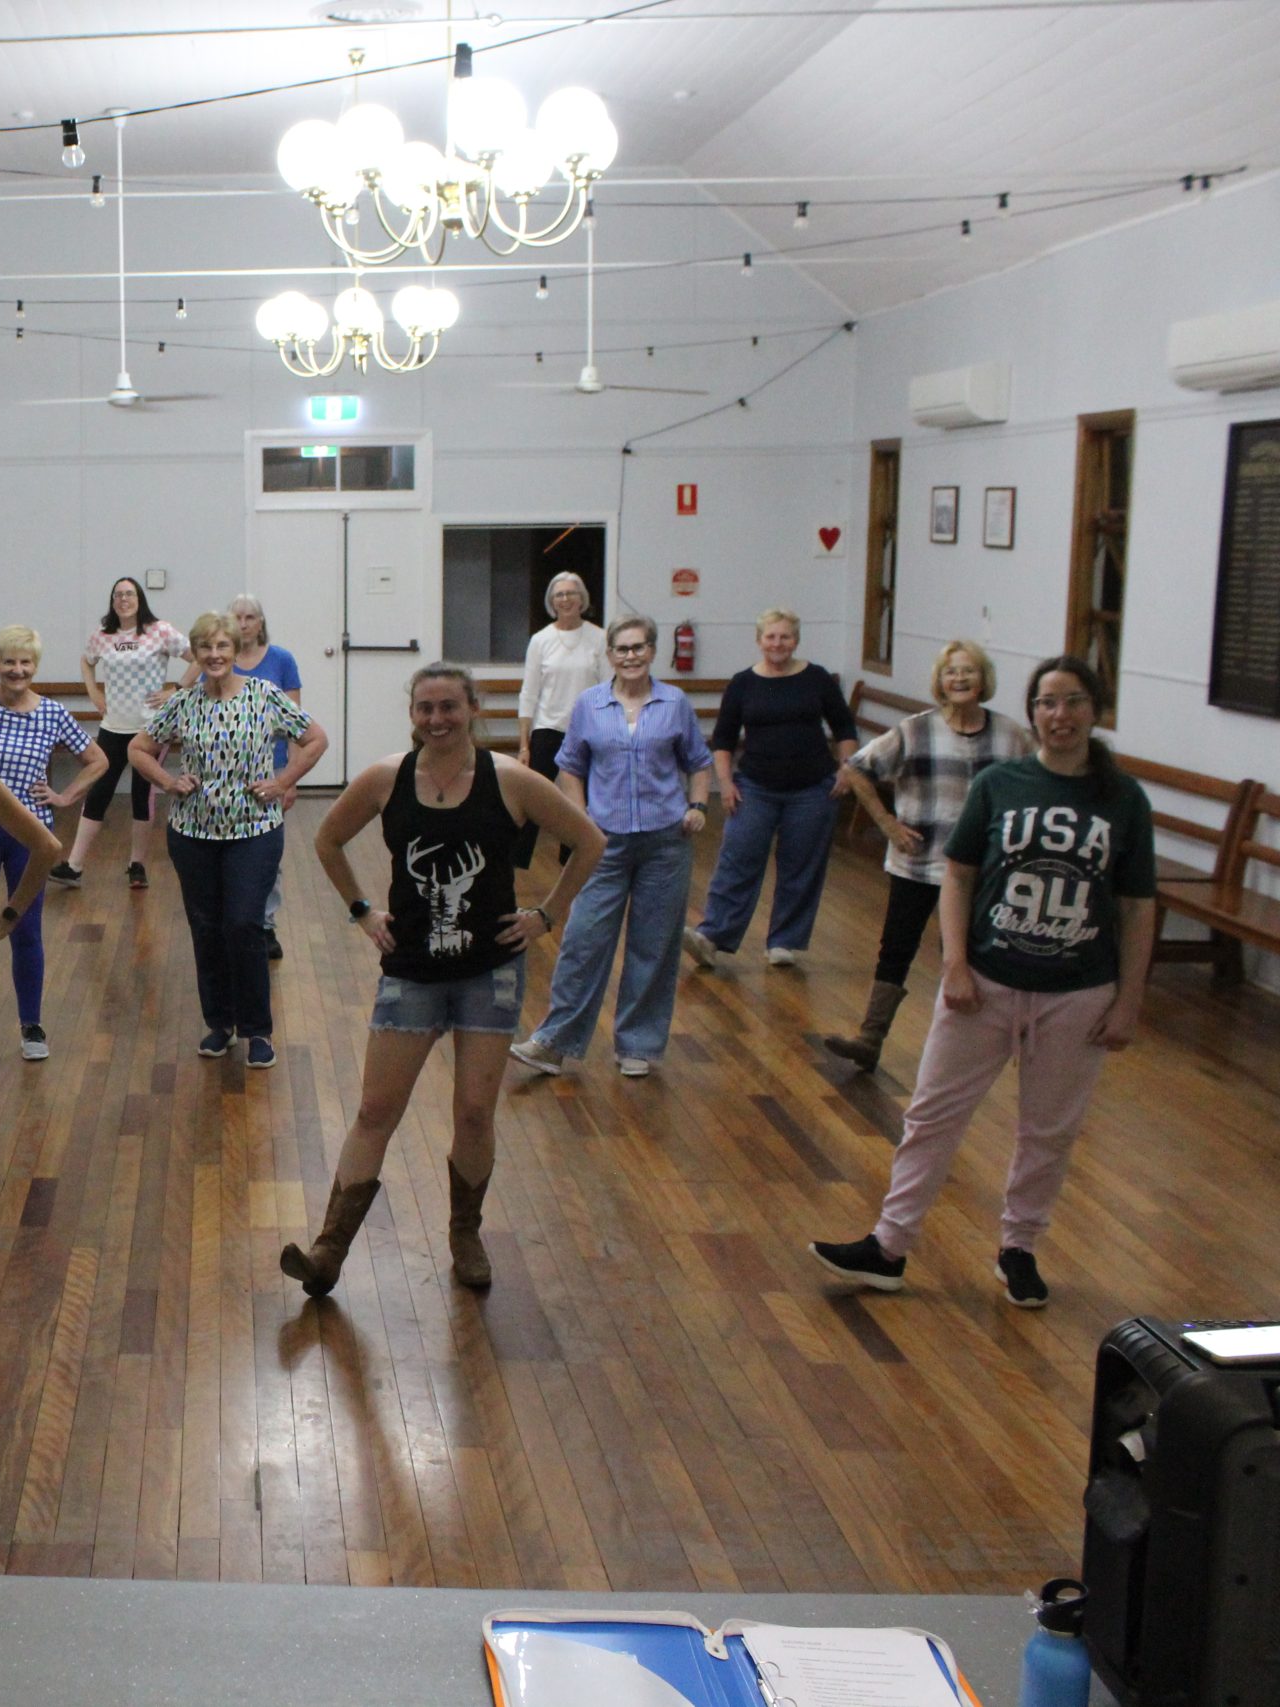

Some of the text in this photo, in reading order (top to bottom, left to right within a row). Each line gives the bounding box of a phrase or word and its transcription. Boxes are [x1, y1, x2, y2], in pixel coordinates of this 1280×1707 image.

[1001, 806, 1111, 871] USA
[989, 903, 1099, 947] Brooklyn
[1006, 871, 1090, 925] 94
